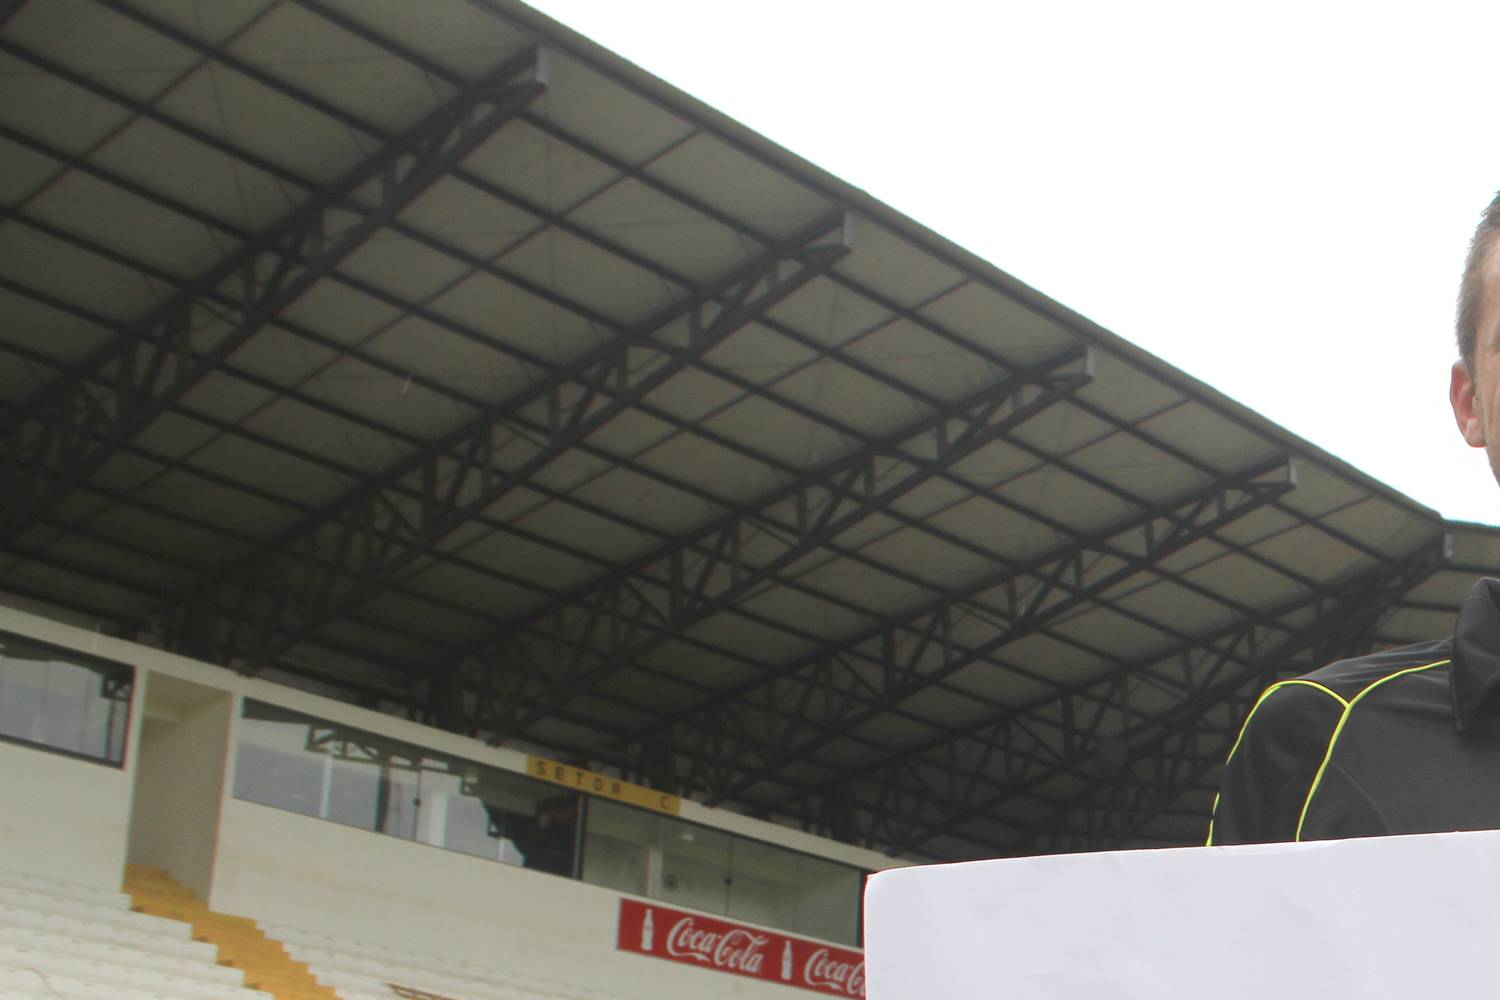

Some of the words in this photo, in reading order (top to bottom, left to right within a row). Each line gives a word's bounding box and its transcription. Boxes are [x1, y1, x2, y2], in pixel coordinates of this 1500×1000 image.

[535, 760, 622, 797] SETOR
[659, 795, 672, 809] C
[666, 917, 769, 973] Coca-Cola
